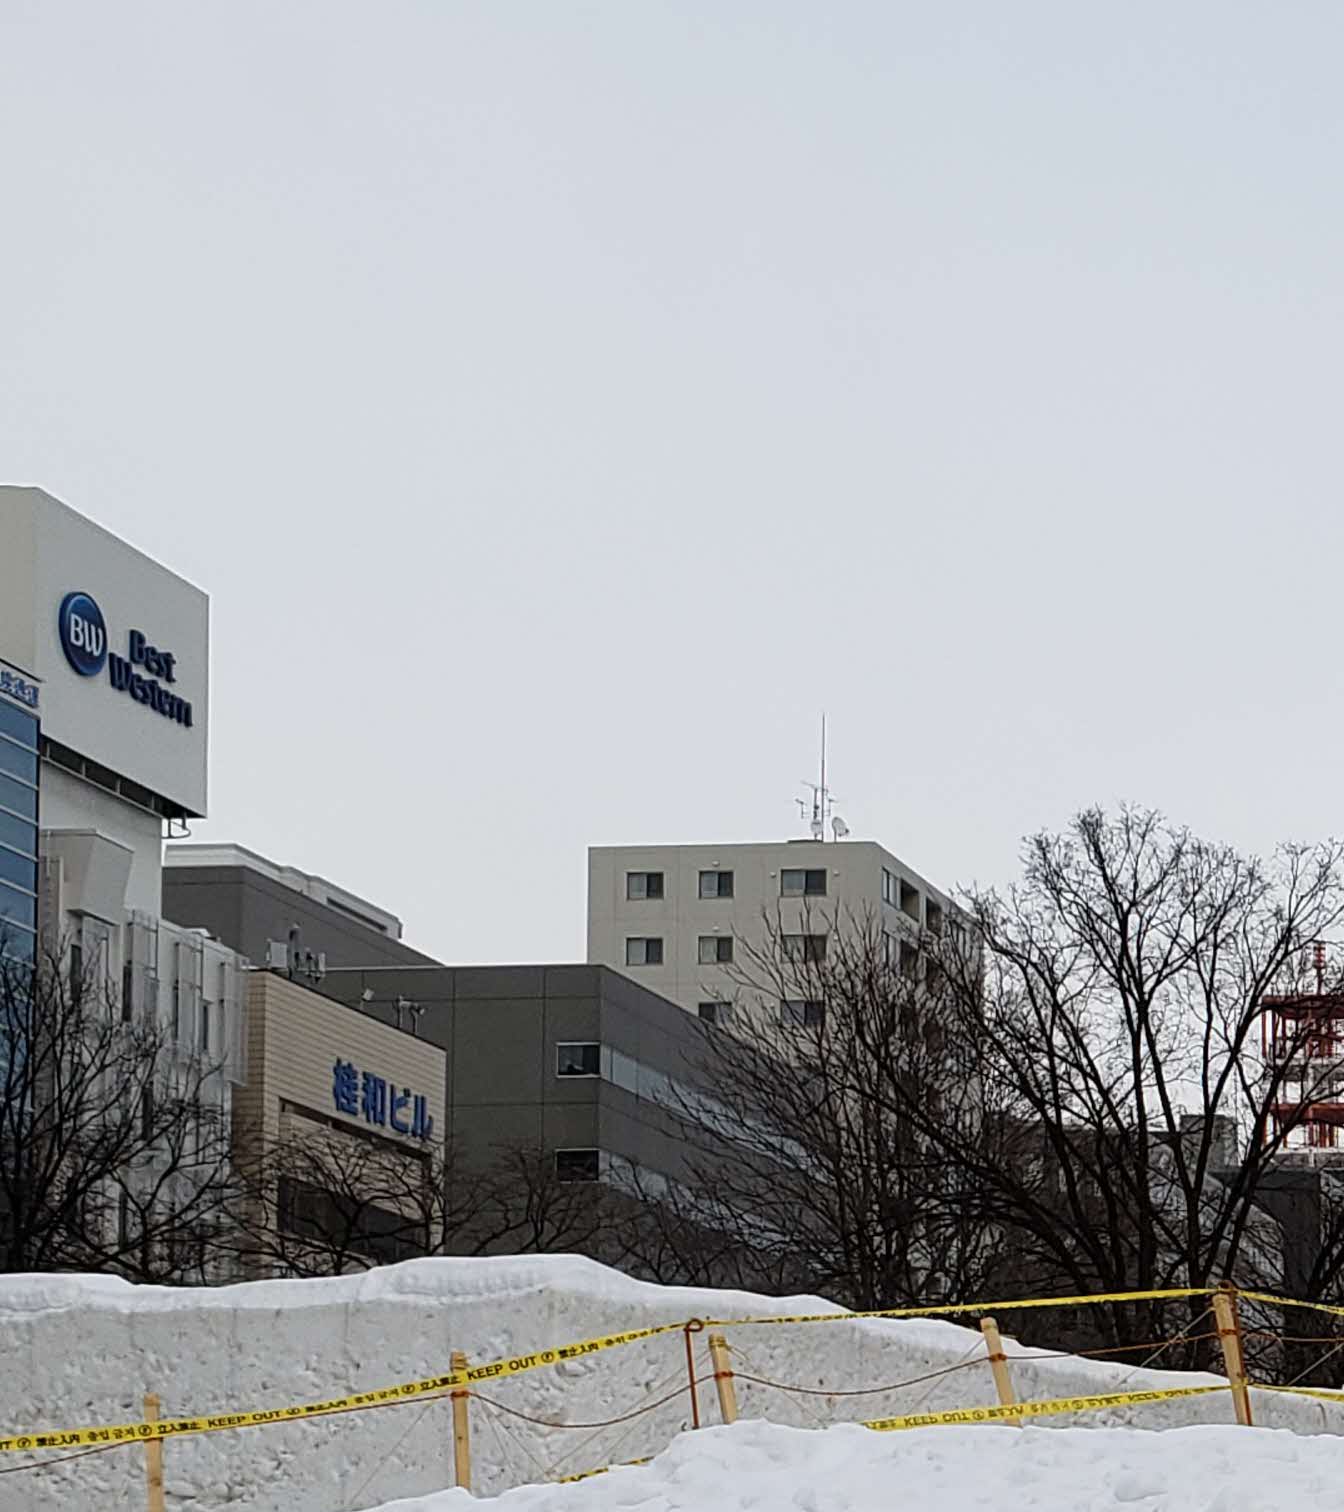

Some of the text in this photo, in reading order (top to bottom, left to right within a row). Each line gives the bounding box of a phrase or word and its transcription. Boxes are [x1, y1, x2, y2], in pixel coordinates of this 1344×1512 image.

[69, 613, 103, 657] BW
[129, 629, 177, 683] Best
[108, 652, 193, 728] Western
[207, 1415, 246, 1428] KEEP
[252, 1410, 282, 1421] OUT
[467, 1363, 503, 1381] KEEP
[508, 1355, 538, 1371] OUT
